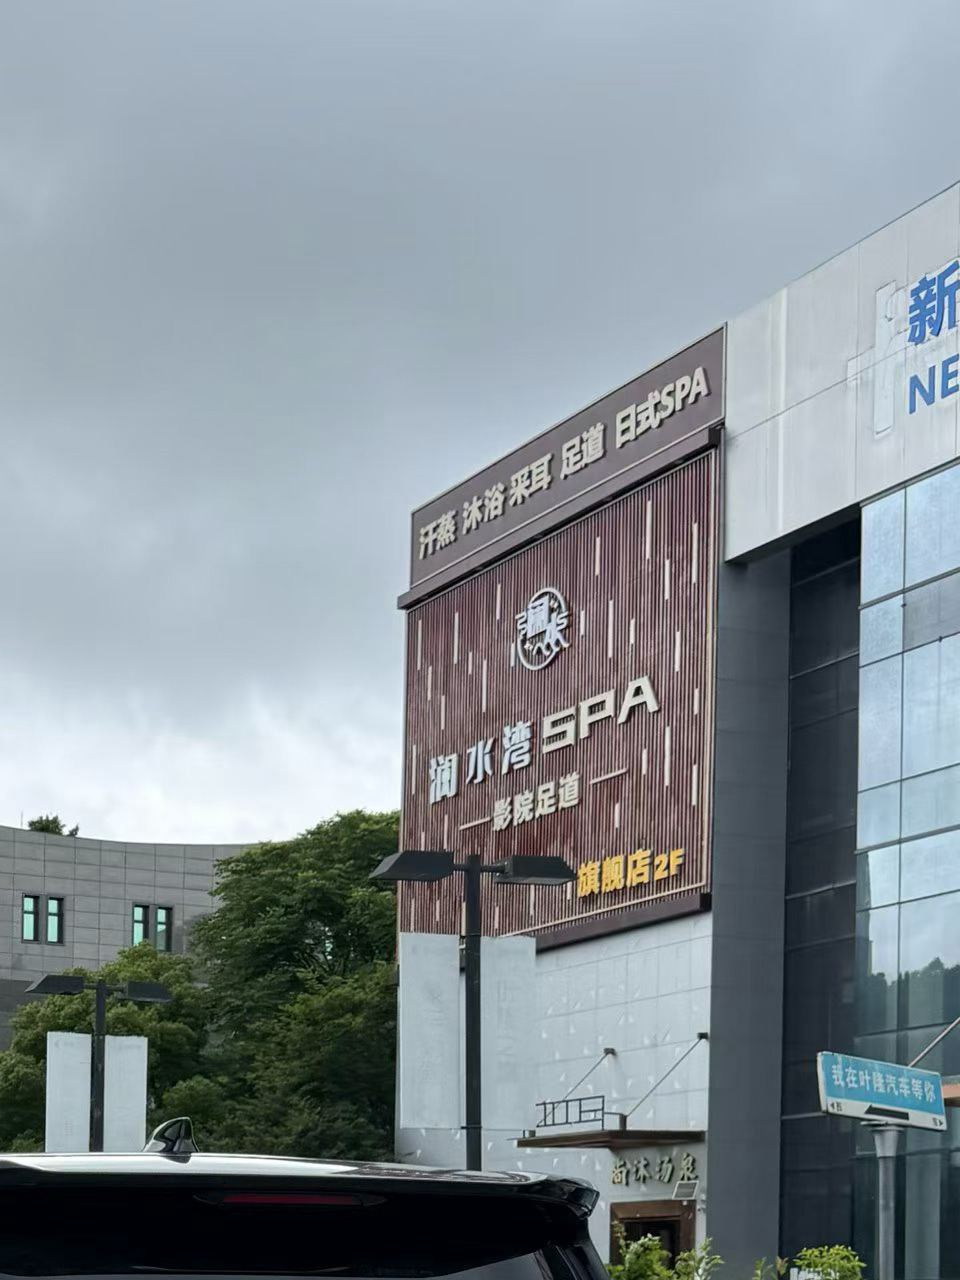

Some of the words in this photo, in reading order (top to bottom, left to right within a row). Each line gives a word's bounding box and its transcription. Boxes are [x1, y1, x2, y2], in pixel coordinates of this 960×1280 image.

[907, 260, 960, 345] 新
[419, 510, 458, 560] 汗蒸
[462, 482, 507, 535] 沐浴
[509, 453, 554, 506] 采耳
[560, 422, 606, 480] 足道
[615, 366, 710, 449] 日式SPA
[493, 771, 581, 831] 影院足道
[577, 848, 685, 898] 旗舰店2F
